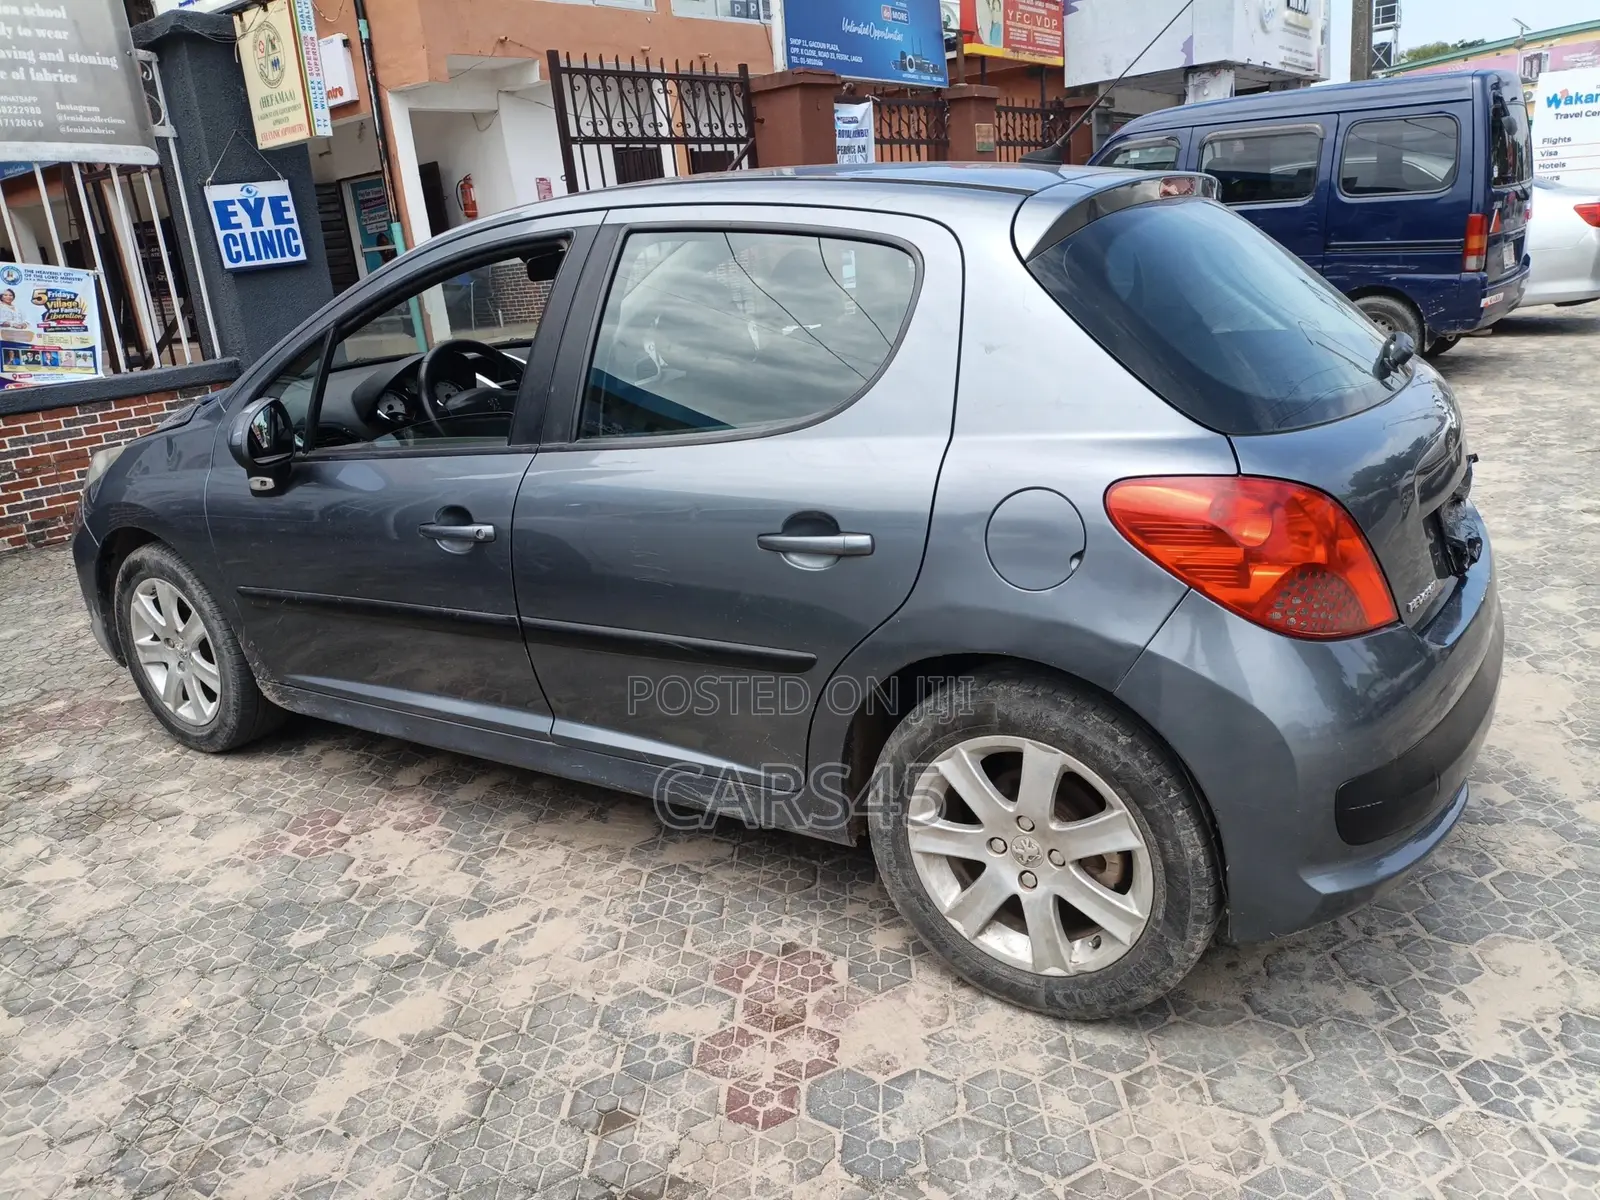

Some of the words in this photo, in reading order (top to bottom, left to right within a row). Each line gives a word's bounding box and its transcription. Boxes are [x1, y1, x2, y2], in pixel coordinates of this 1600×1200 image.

[22, 3, 67, 20] school
[892, 11, 908, 22] MORE
[17, 25, 32, 37] to
[35, 28, 69, 40] wear
[842, 16, 870, 36] Unlimited
[870, 21, 904, 42] Opportunities
[789, 38, 802, 46] SHOP
[827, 43, 840, 52] PLAZA,
[39, 48, 65, 62] and
[68, 52, 119, 70] stoning
[303, 35, 315, 77] SUPERIOR
[310, 36, 321, 77] SUPERIOR
[12, 67, 26, 80] of
[29, 67, 78, 83] fabrics
[310, 80, 319, 109] WILLEX
[317, 80, 326, 110] WILLEX
[56, 102, 100, 113] Instagram
[1554, 110, 1583, 120] Travel
[1542, 136, 1572, 145] Flights
[1538, 161, 1567, 170] Hotels
[213, 195, 295, 231] EYE
[222, 227, 301, 264] CLINIC
[31, 288, 48, 306] 5
[47, 291, 76, 299] Fridays
[46, 299, 79, 309] Village
